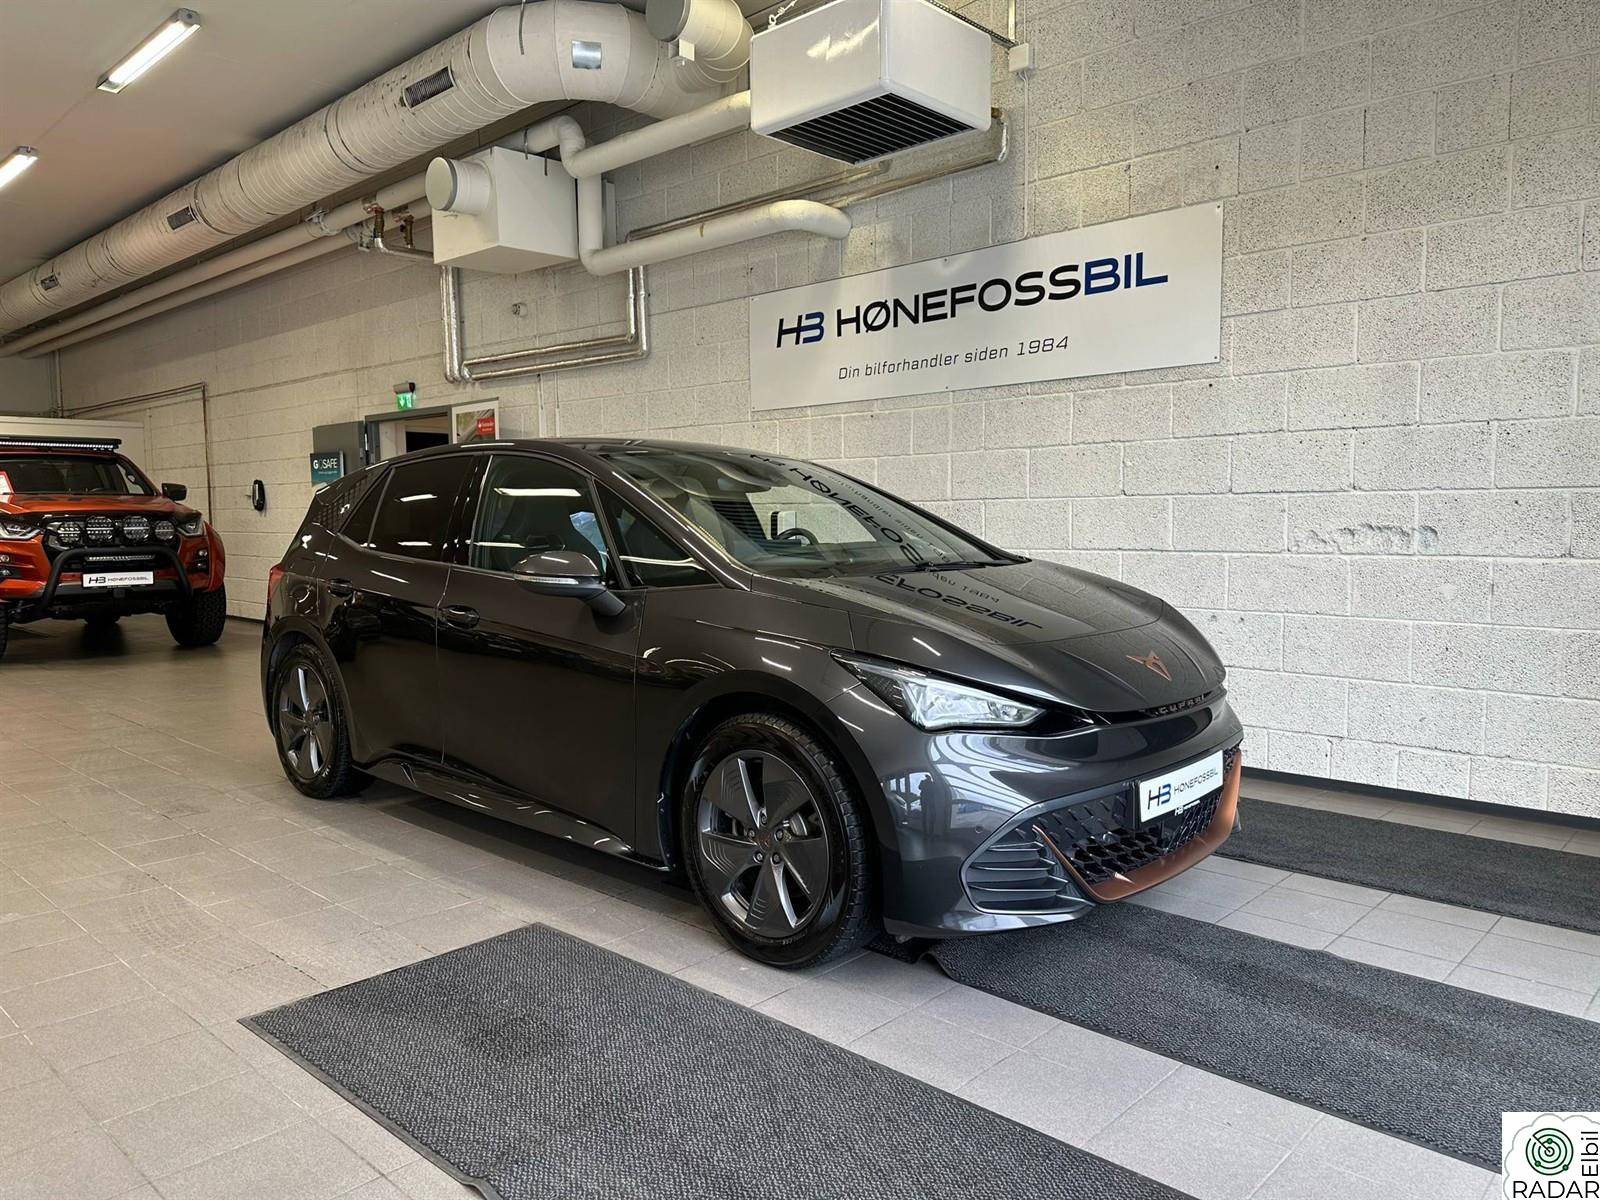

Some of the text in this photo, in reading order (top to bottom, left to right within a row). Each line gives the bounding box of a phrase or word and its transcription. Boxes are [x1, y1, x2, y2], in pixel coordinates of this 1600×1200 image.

[836, 251, 1169, 337] HØNEFOSSBIL
[838, 335, 1069, 380] Din bilforhandler siden 1984
